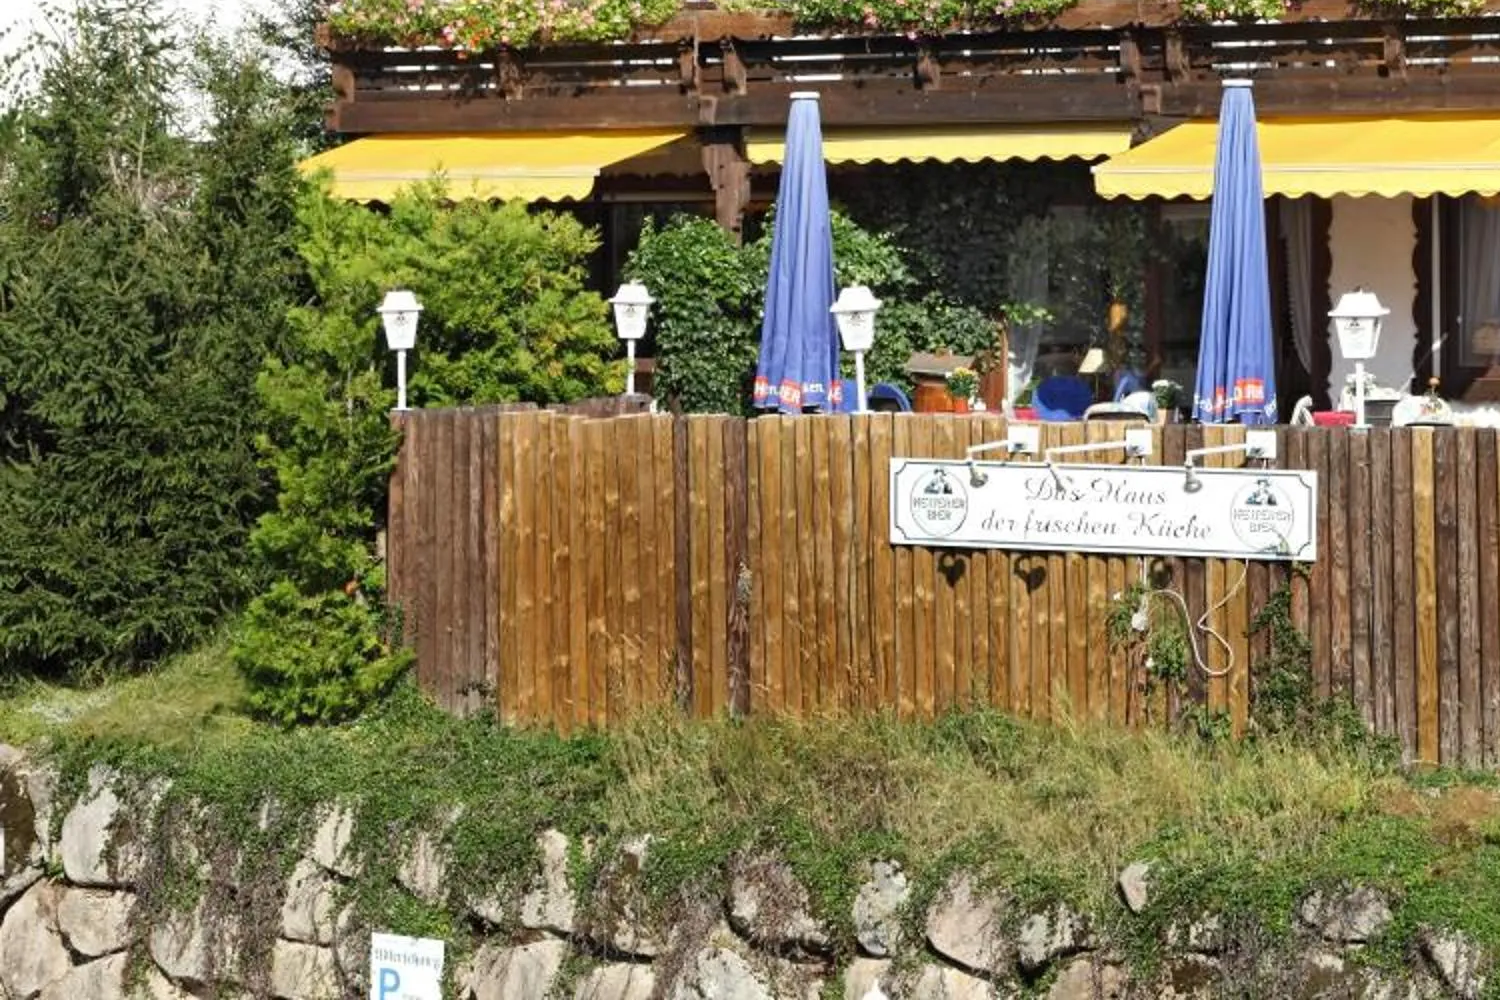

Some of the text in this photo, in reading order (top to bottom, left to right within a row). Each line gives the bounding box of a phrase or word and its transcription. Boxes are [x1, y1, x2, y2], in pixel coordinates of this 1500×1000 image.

[1024, 475, 1168, 505] Das Haus
[981, 508, 1212, 540] der frischen Küche
[379, 967, 401, 1000] P
